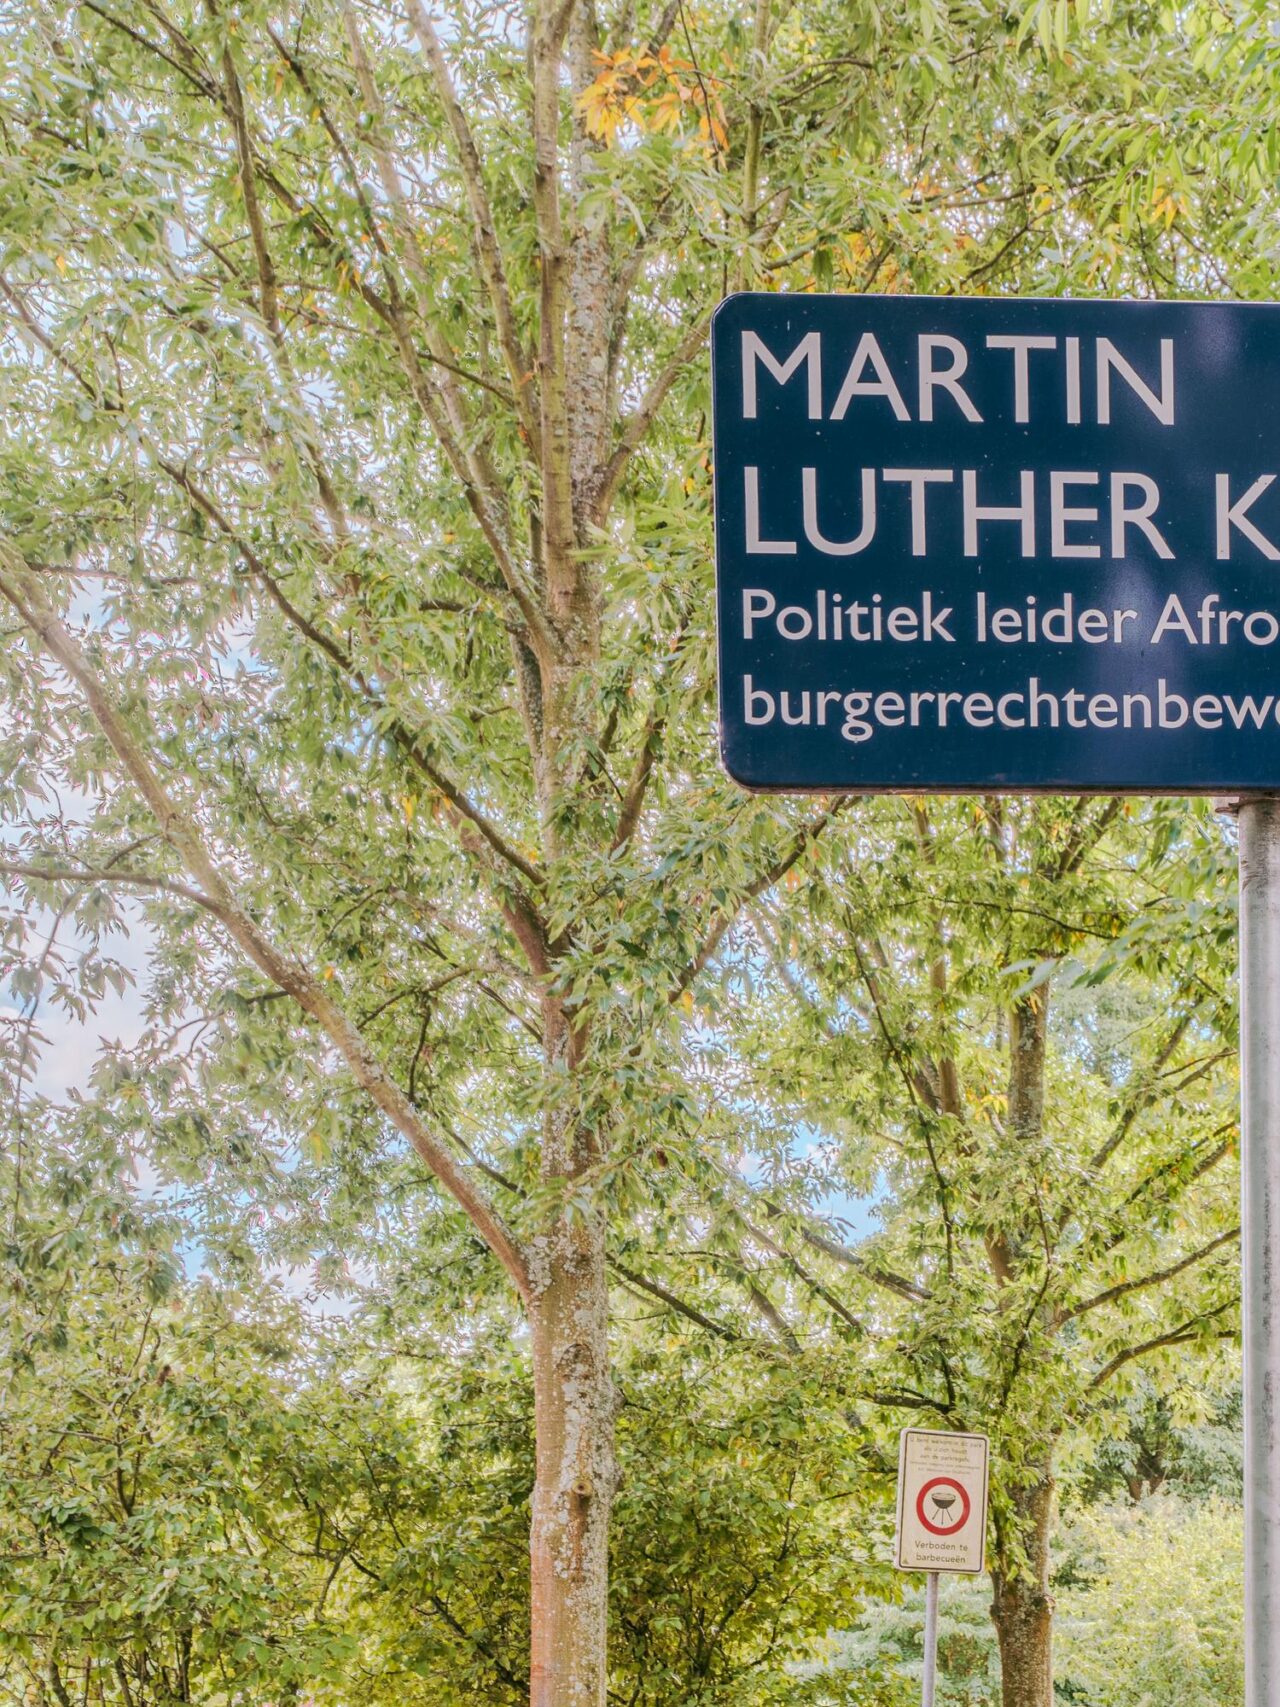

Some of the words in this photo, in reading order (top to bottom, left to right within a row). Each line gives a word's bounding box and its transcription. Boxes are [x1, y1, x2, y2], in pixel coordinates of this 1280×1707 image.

[741, 330, 1176, 426] MARTIN
[744, 466, 1176, 560] LUTHER
[742, 589, 956, 642] Politiek
[977, 592, 1138, 644] leider
[914, 1540, 956, 1551] Verboden
[959, 1543, 969, 1552] te
[915, 1553, 967, 1564] barbecueën
